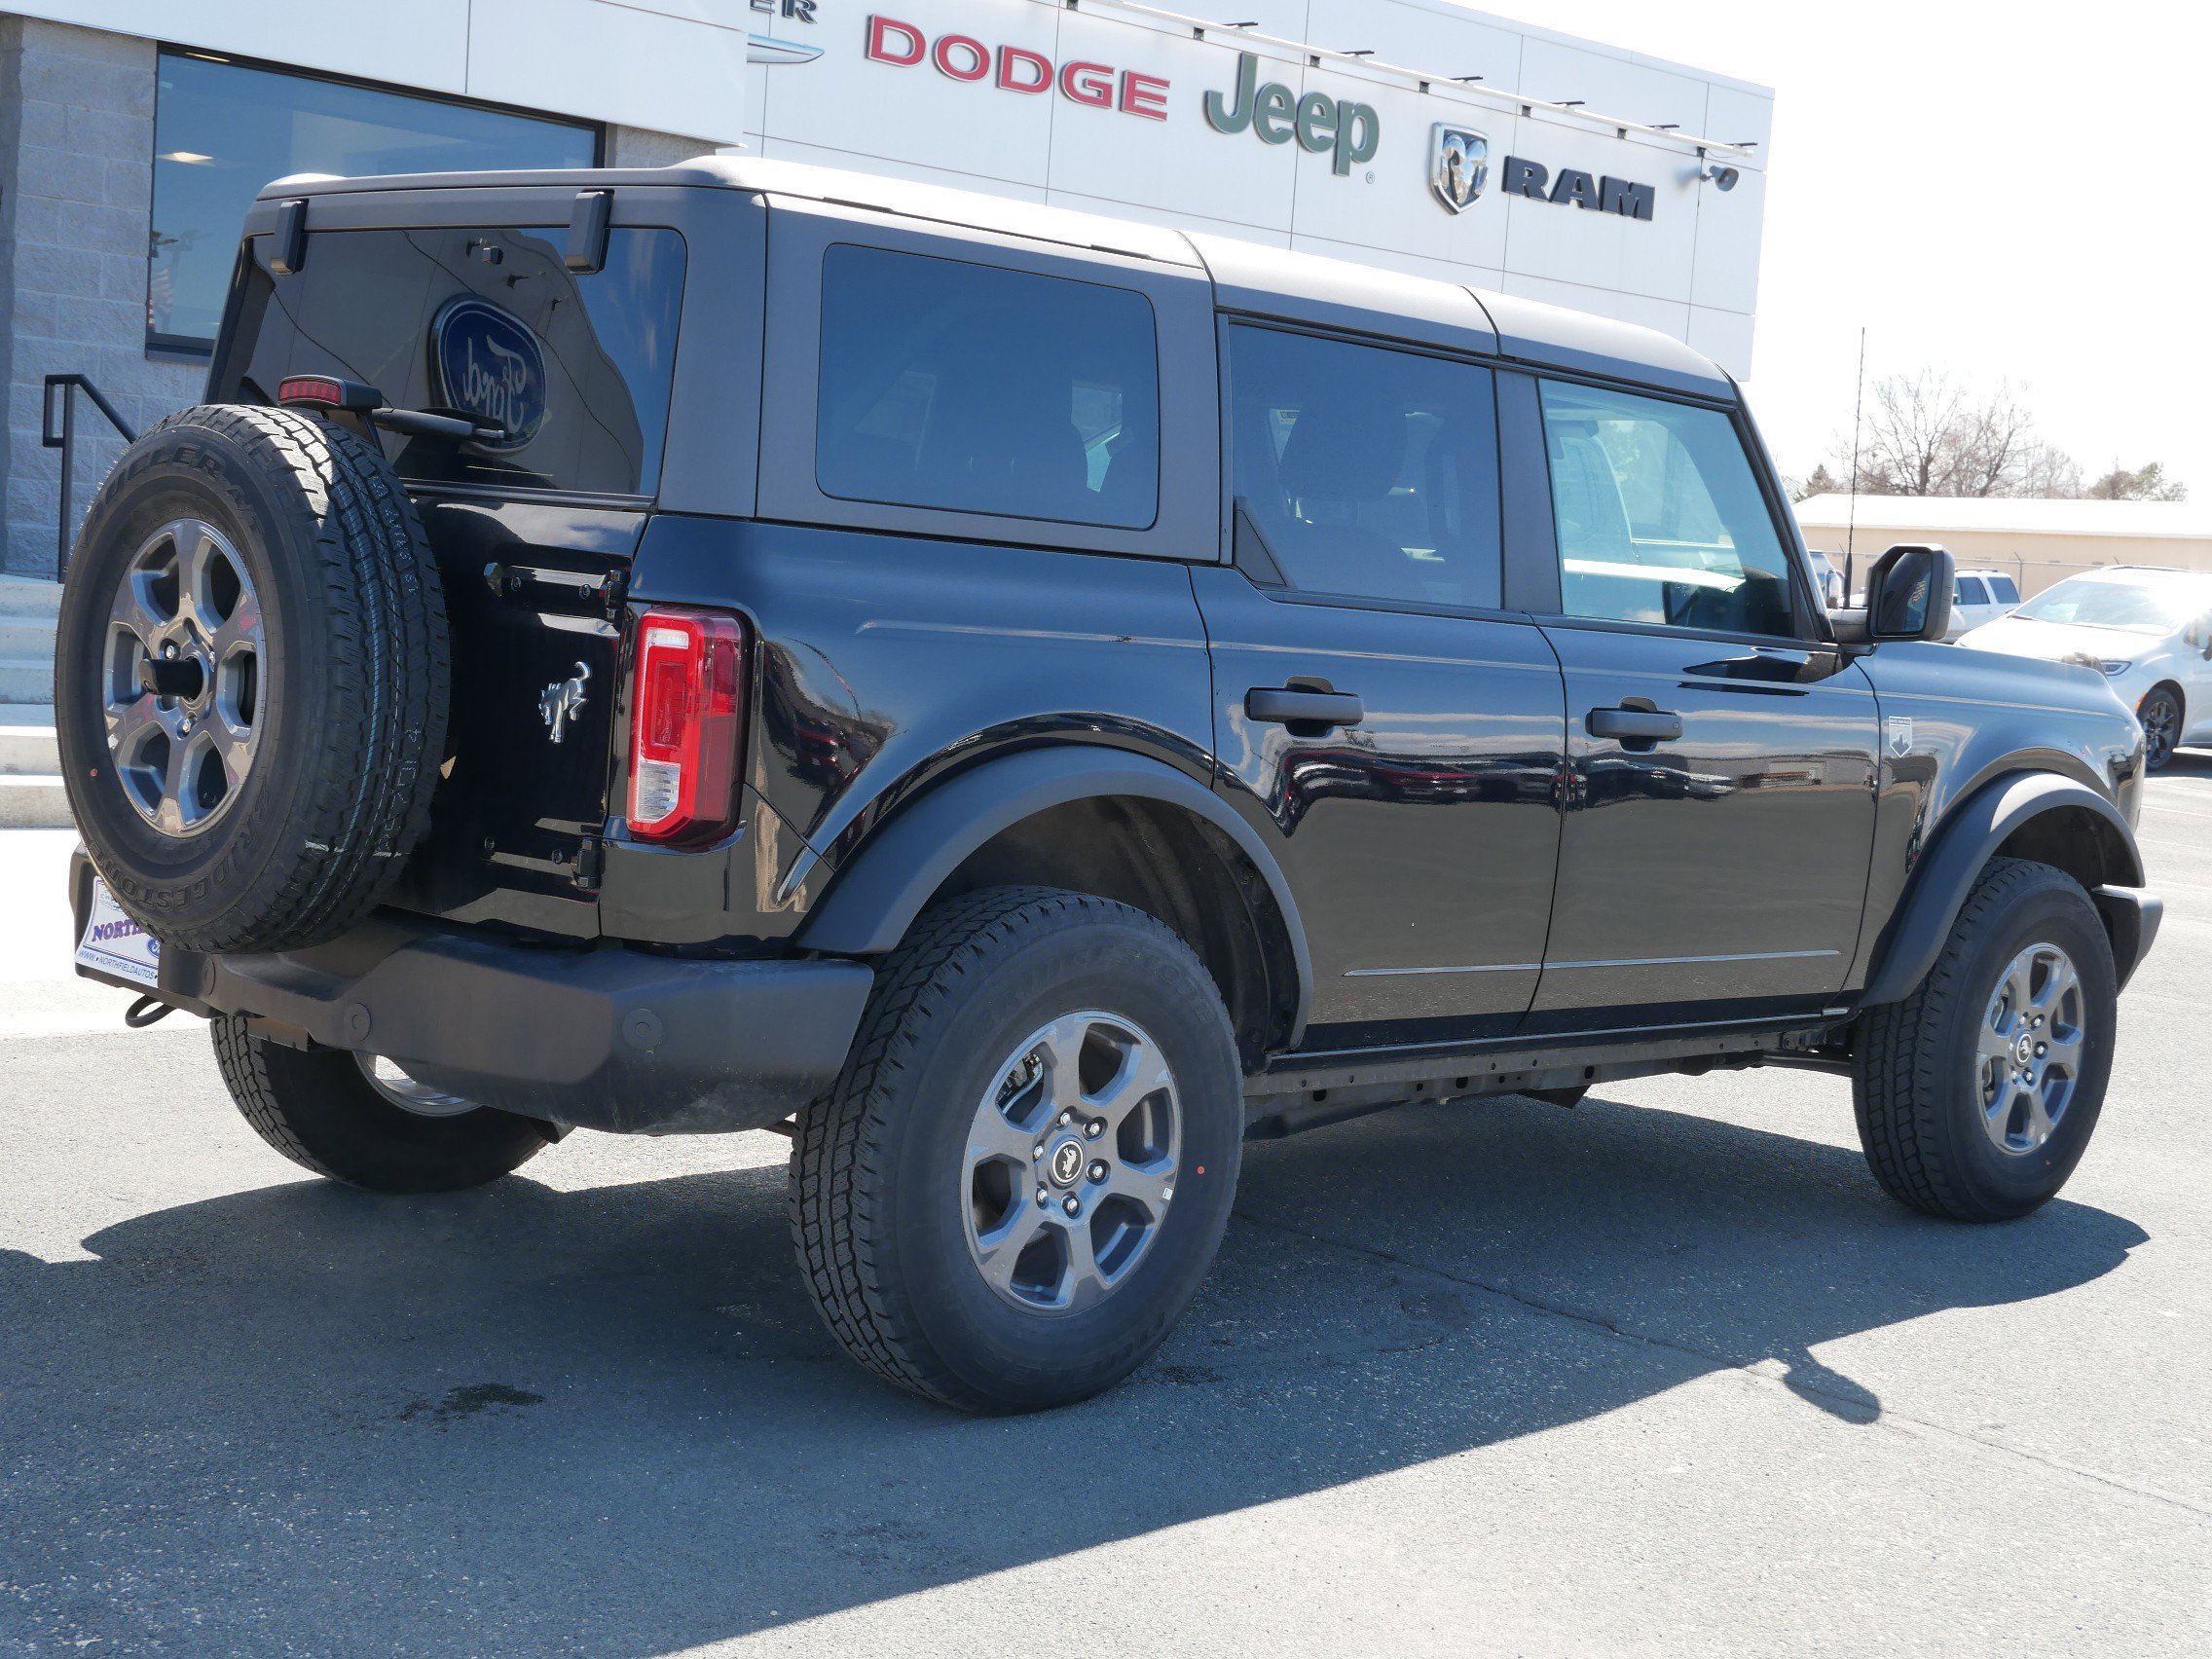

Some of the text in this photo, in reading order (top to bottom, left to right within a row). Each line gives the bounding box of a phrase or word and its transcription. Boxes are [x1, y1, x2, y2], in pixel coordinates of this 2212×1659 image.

[866, 14, 1171, 122] DODGE
[1202, 51, 1381, 176] Jeep
[1501, 155, 1656, 222] RAM
[88, 781, 273, 913] BRIDGESTONE
